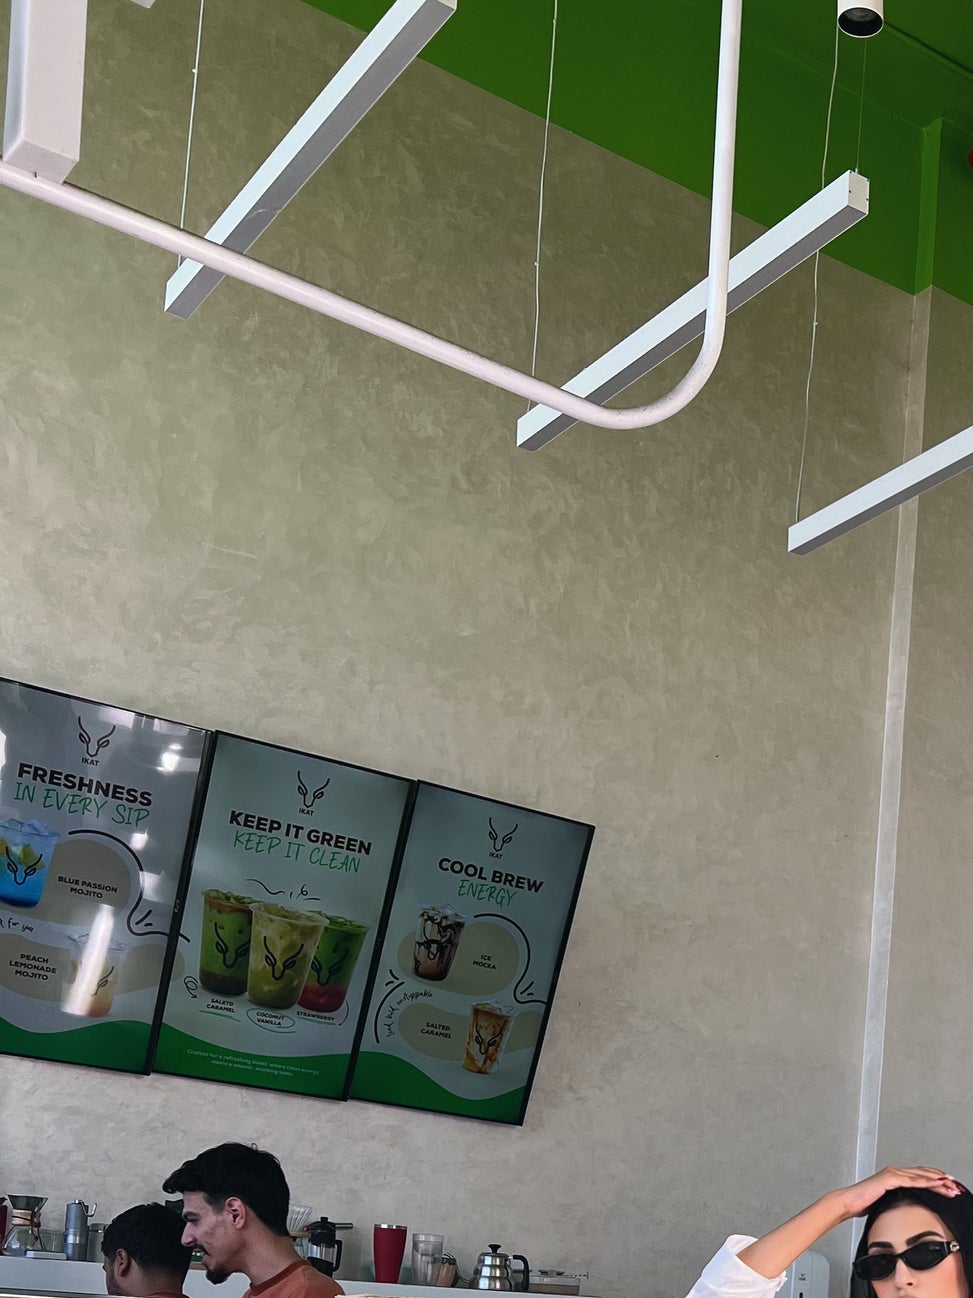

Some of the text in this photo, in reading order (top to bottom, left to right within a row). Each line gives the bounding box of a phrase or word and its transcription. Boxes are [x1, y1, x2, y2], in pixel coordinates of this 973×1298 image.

[81, 757, 100, 766] IKAT
[17, 763, 152, 807] FRESHNESS
[13, 782, 149, 828] IN EVERY SIP
[229, 810, 372, 856] KEEP IT GREEN
[233, 830, 361, 873] KEEP IT CLEAN
[438, 857, 544, 893] COOL BREW
[58, 876, 118, 893] BLUE PASSION
[70, 887, 103, 899] MOJITO
[457, 879, 518, 908] ENERGY
[20, 953, 49, 964] PEACH
[9, 960, 57, 974] LEMONADE
[14, 969, 49, 981] MOJITO
[206, 1004, 235, 1013] CARAMEL
[256, 1011, 285, 1021] COCONUT
[296, 1010, 335, 1022] STRAWBERRY
[256, 1018, 282, 1027] VANILLA
[426, 1022, 451, 1031] SALTED
[420, 1028, 453, 1039] CARAMEL
